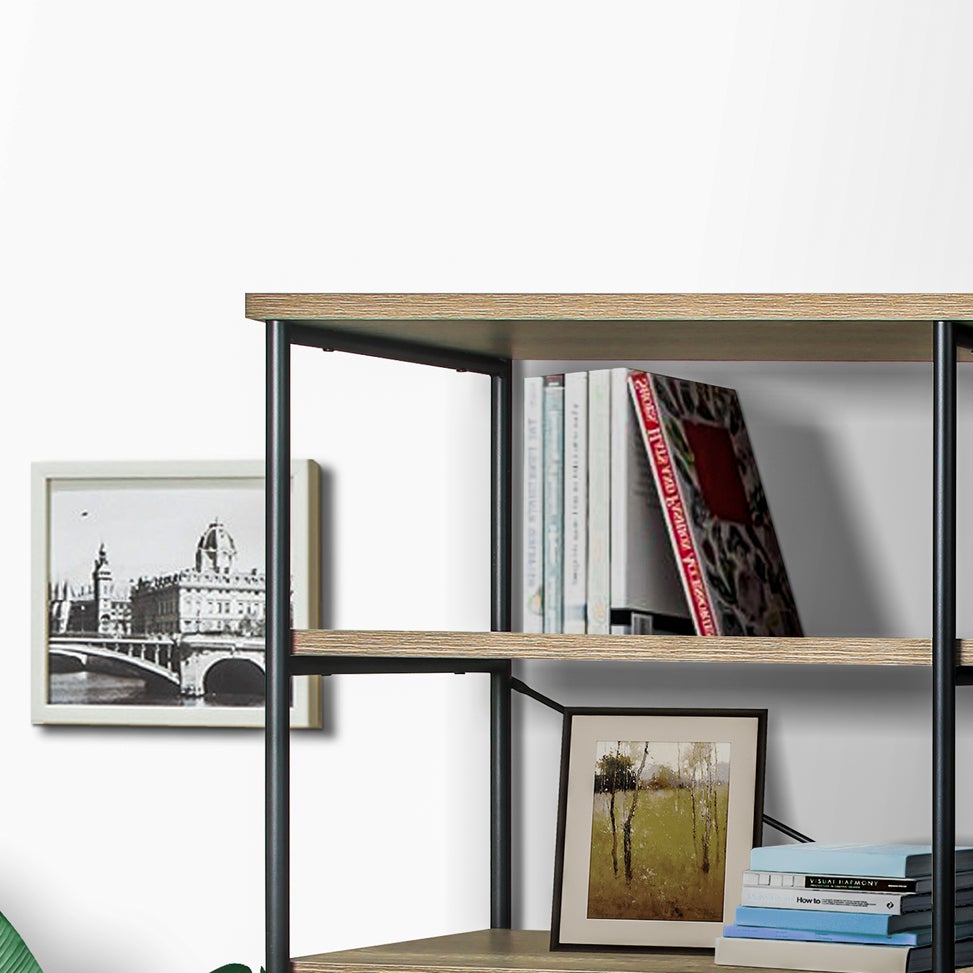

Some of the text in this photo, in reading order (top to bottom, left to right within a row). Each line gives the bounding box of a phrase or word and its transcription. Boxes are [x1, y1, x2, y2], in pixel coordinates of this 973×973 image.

[838, 879, 879, 887] HARMONY
[796, 896, 813, 905] How
[813, 897, 821, 905] to
